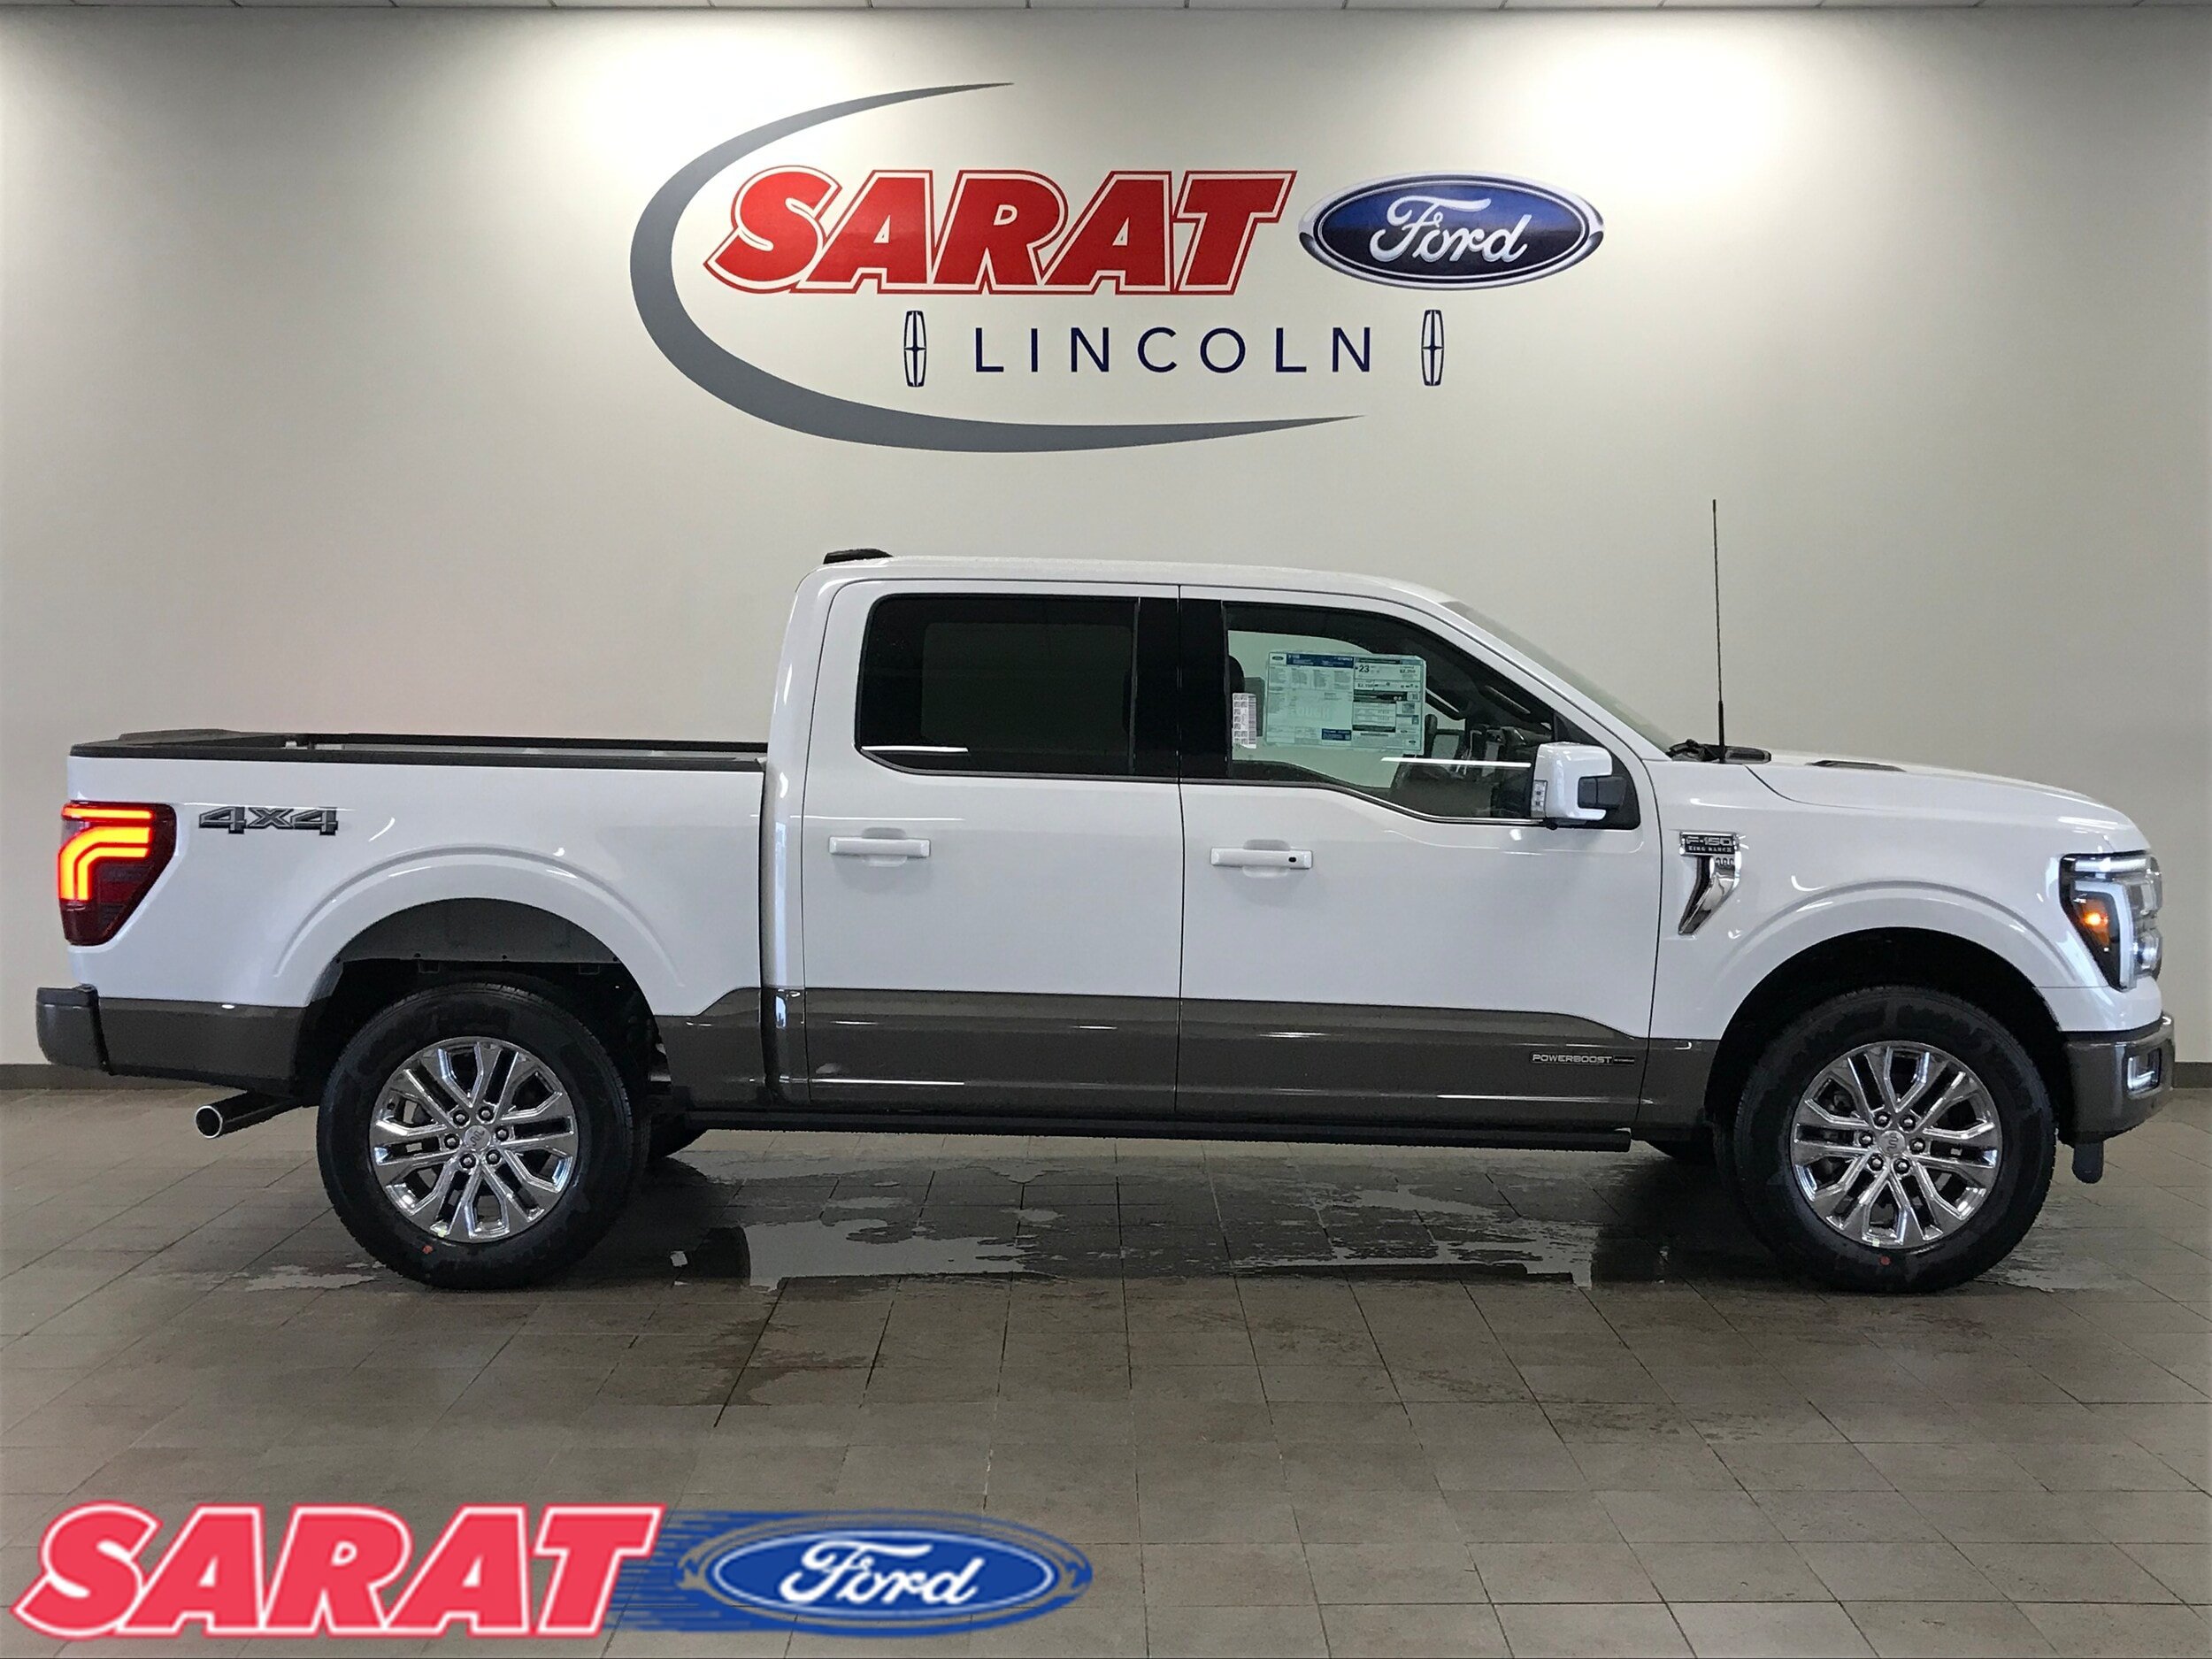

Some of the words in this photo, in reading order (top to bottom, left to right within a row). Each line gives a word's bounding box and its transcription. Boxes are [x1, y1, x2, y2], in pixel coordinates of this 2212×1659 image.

[703, 165, 1297, 295] SARAT
[1370, 194, 1532, 263] Ford
[974, 326, 1371, 373] LINCOLN
[1686, 836, 1732, 846] F-150
[1532, 1054, 1613, 1064] POWERBOOST
